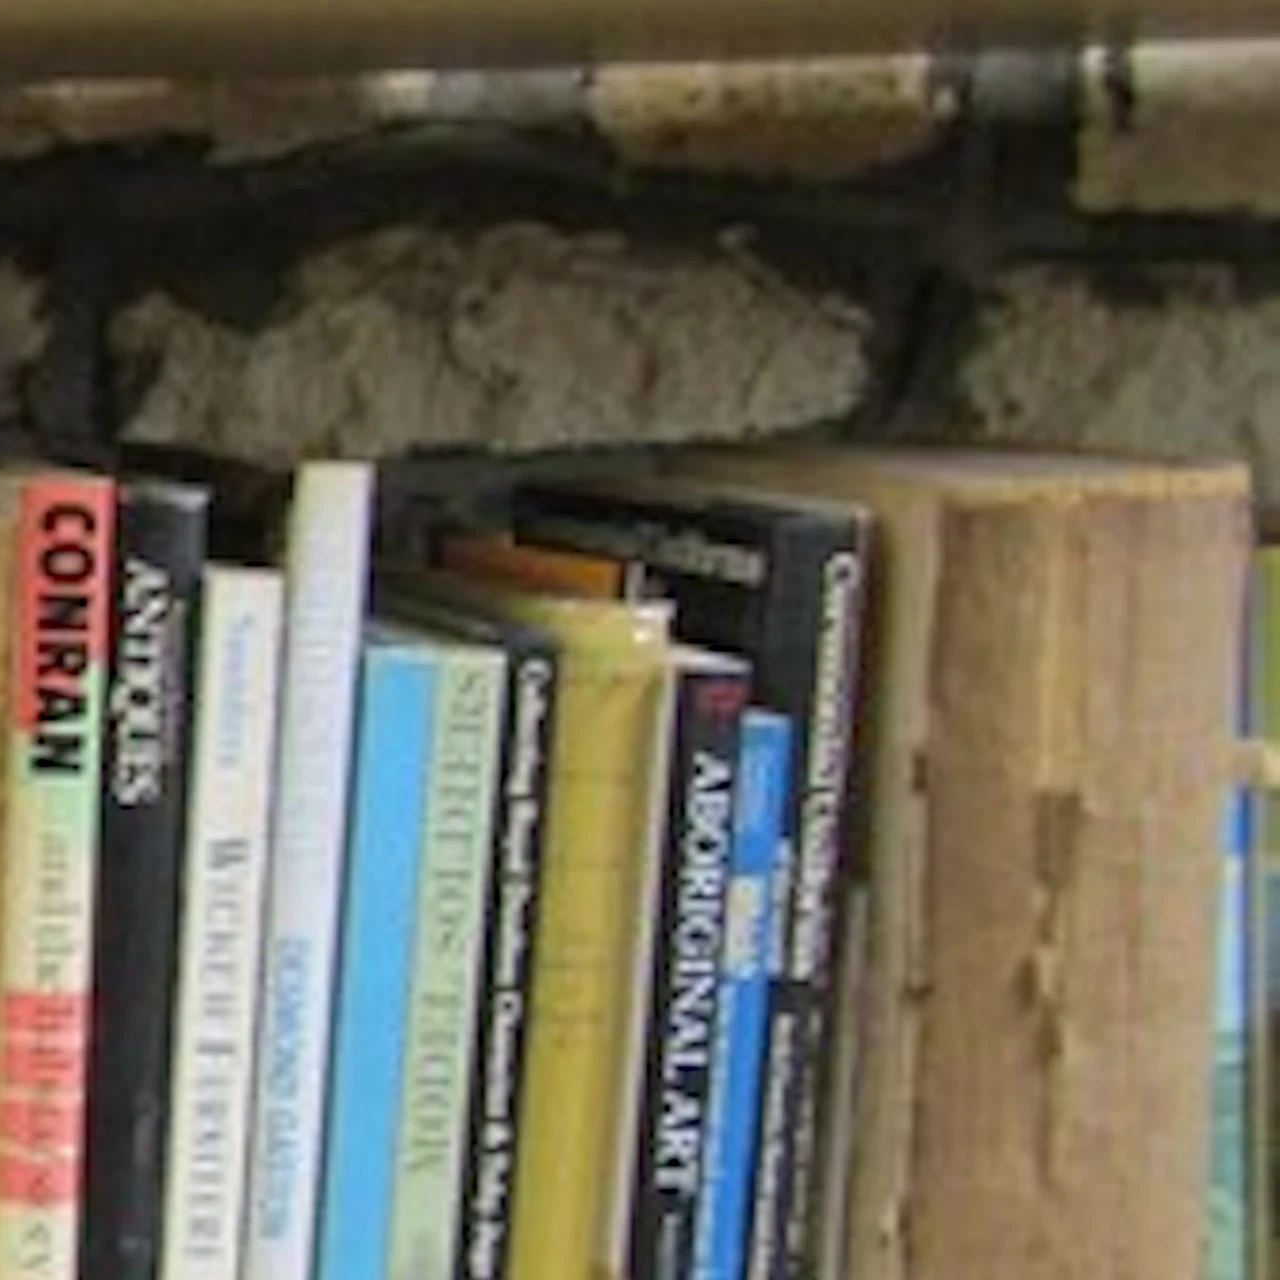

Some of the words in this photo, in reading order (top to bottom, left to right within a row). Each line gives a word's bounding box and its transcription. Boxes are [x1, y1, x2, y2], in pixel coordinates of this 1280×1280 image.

[31, 502, 96, 776] CONRAN
[109, 557, 172, 809] ANTIQUES
[664, 752, 735, 1079] ABORIGINAL
[652, 1093, 704, 1195] ART
